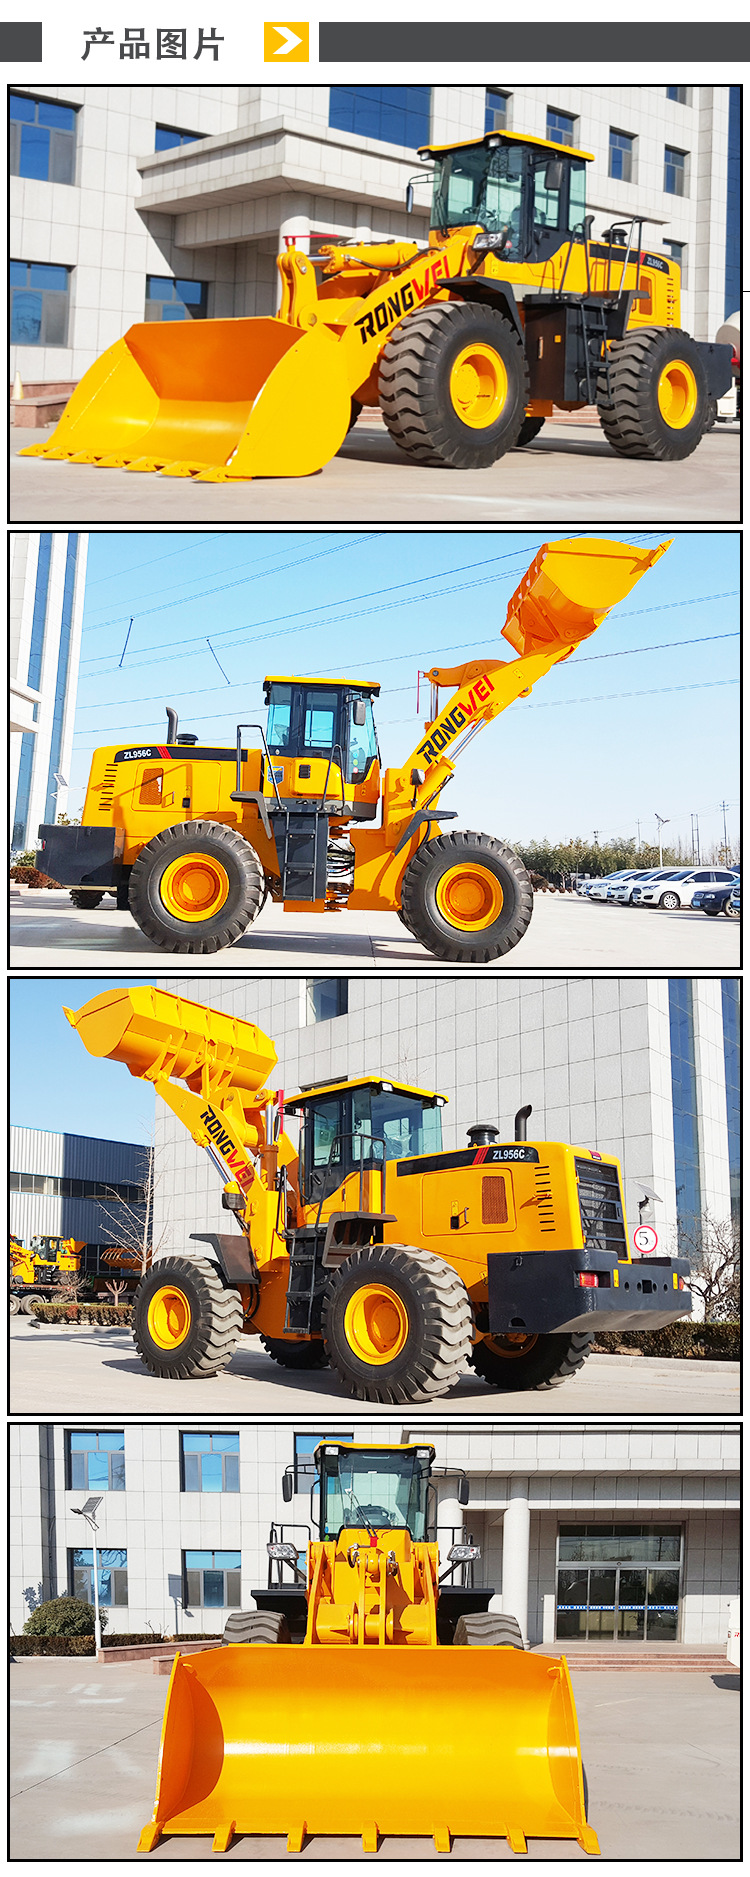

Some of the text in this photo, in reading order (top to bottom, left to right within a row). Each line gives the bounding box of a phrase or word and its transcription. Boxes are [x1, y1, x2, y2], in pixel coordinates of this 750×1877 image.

[354, 255, 450, 344] RONGWEI
[416, 674, 495, 764] RONGWEI
[123, 748, 152, 760] ZL956C
[200, 1104, 255, 1188] RONGWEI
[492, 1149, 525, 1160] ZL956C
[639, 1231, 649, 1246] 5
